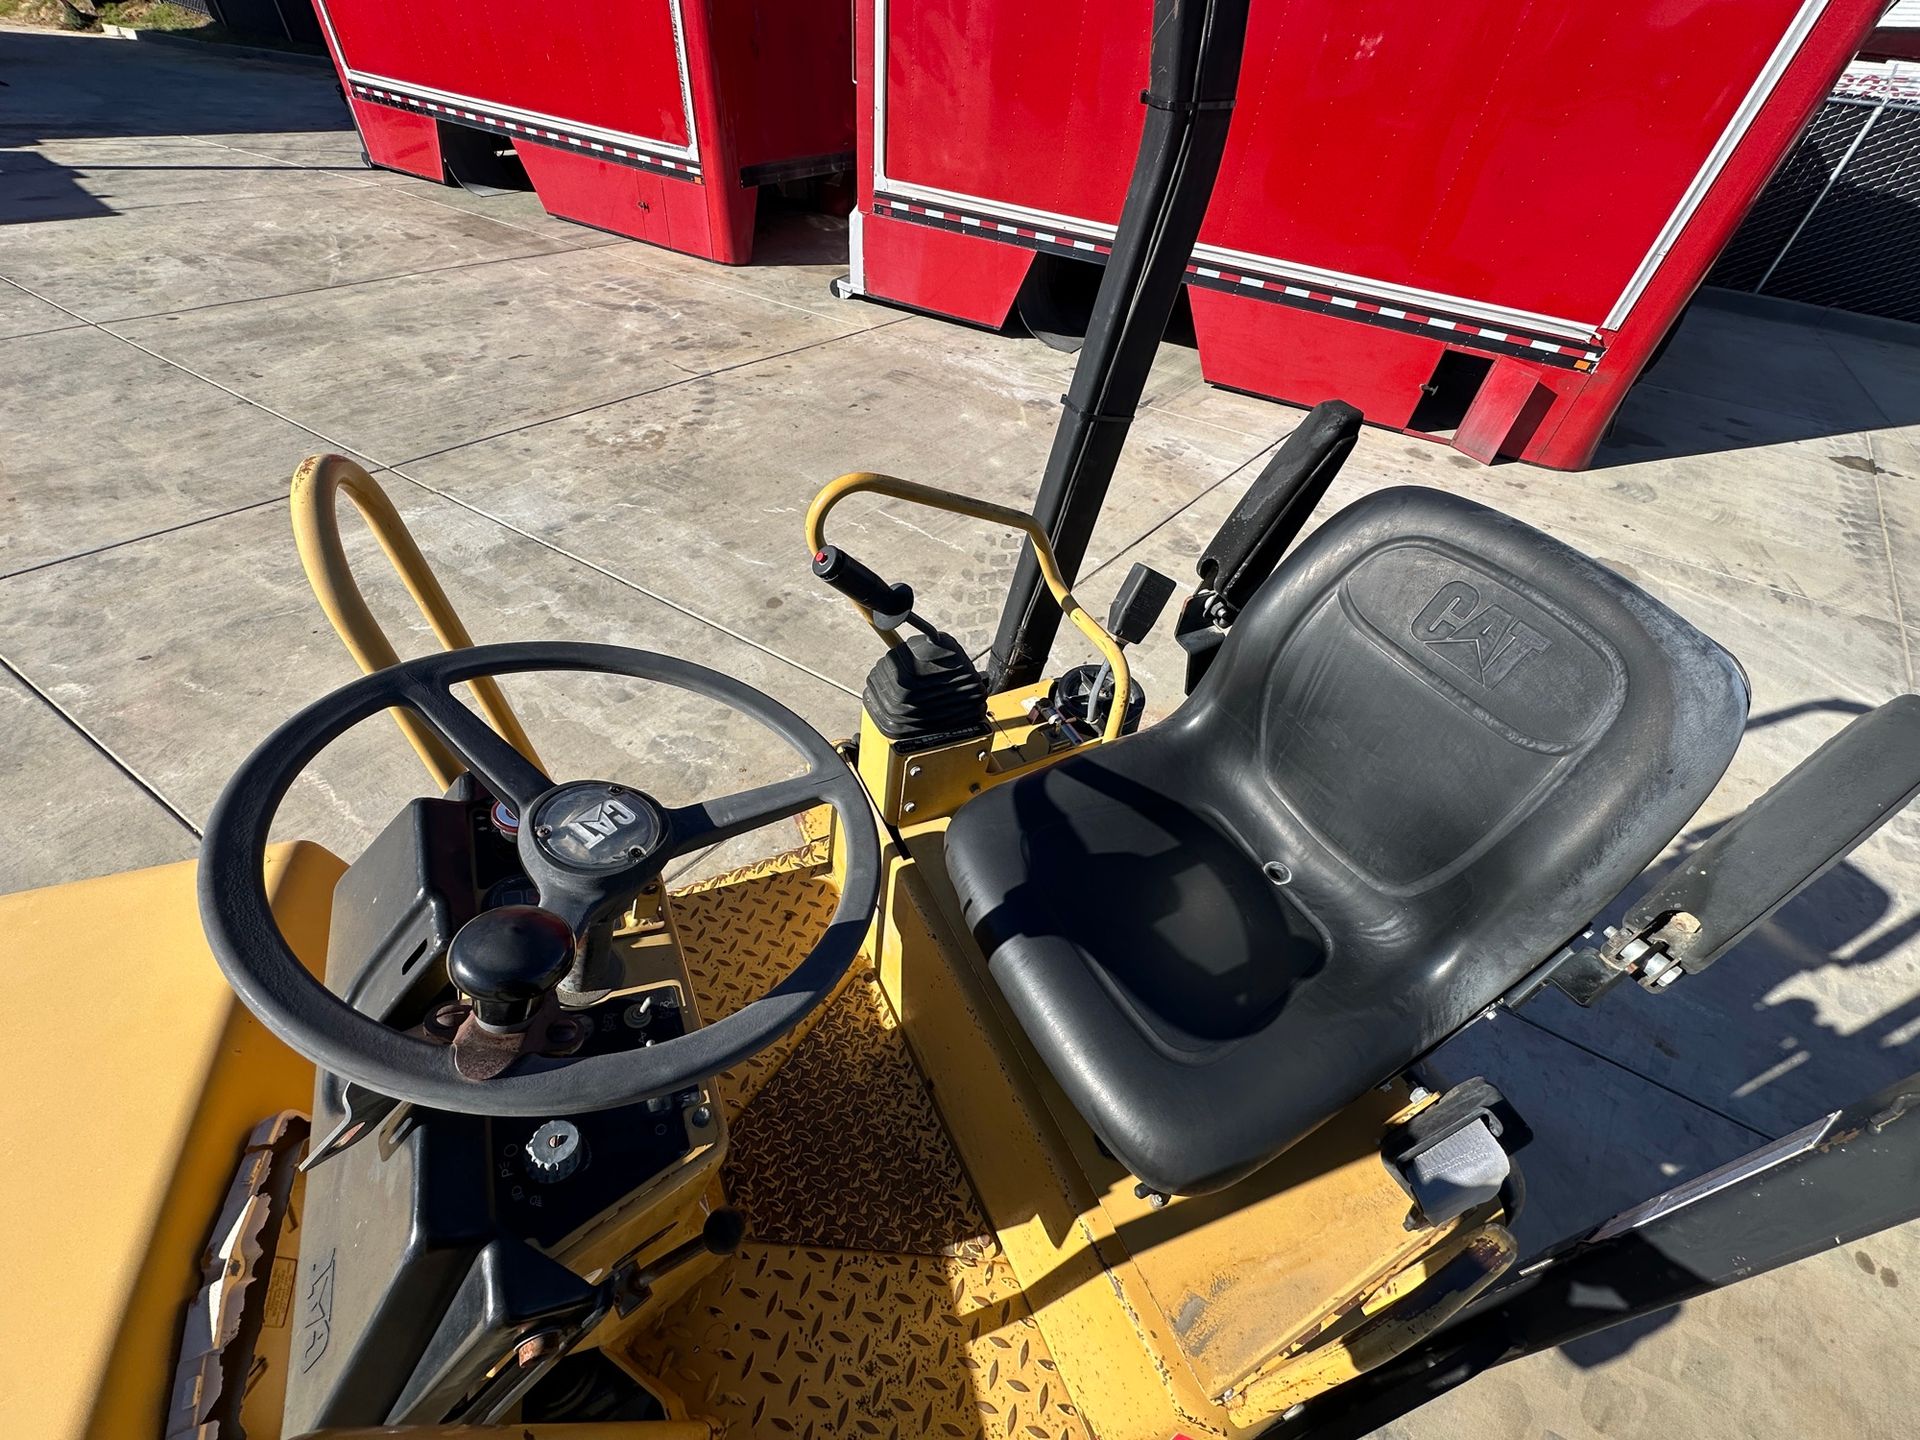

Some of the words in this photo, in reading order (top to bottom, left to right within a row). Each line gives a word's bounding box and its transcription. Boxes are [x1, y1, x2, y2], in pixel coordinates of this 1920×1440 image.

[1410, 580, 1552, 690] CAT
[568, 799, 637, 850] CAT
[304, 1248, 336, 1374] CAT
